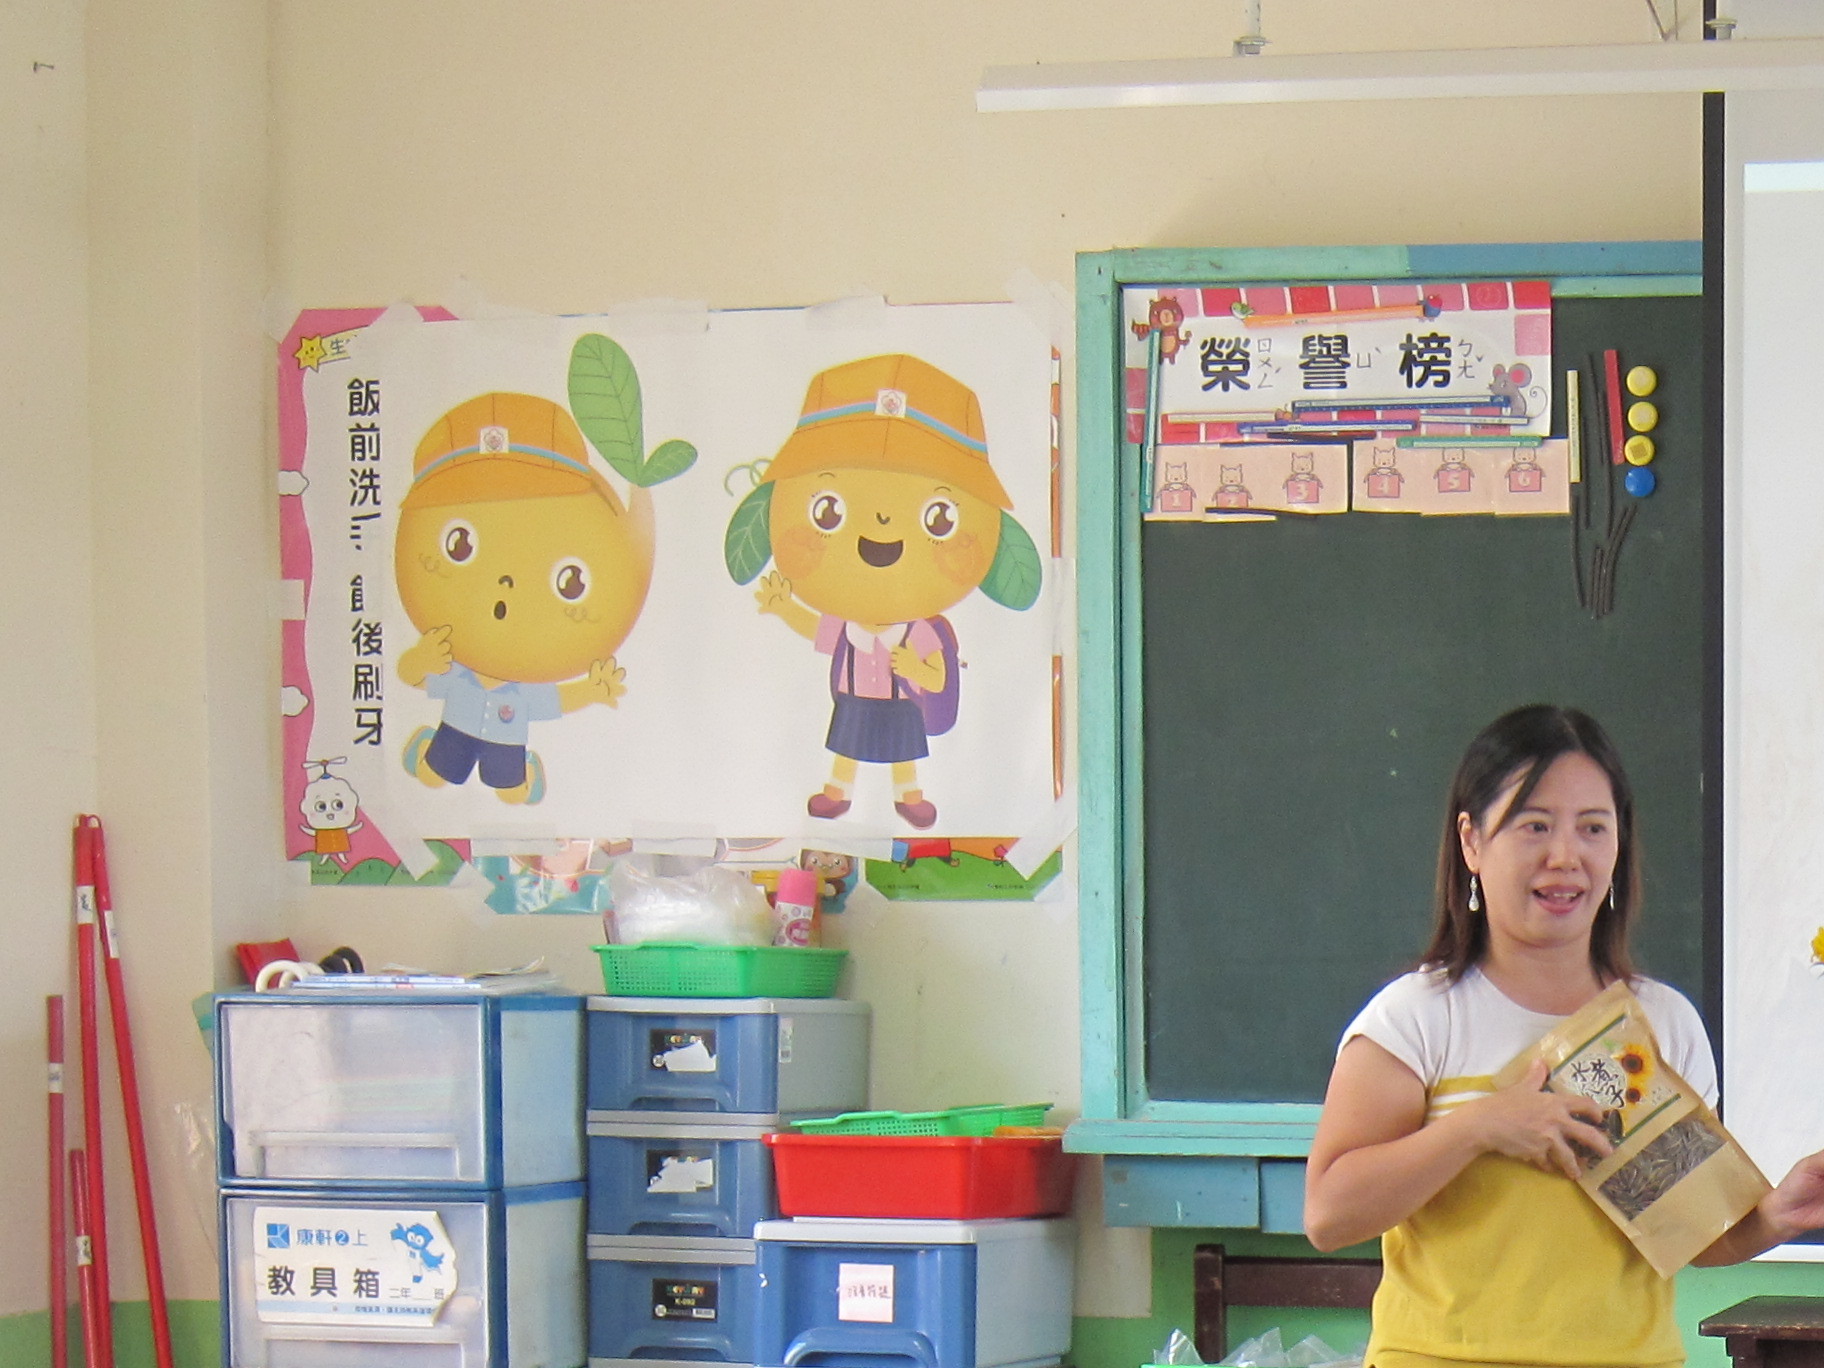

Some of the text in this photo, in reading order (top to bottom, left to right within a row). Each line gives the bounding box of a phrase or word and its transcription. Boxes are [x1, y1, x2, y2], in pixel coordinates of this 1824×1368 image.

[1199, 332, 1453, 393] 榮譽榜
[267, 1265, 380, 1298] 教具箱
